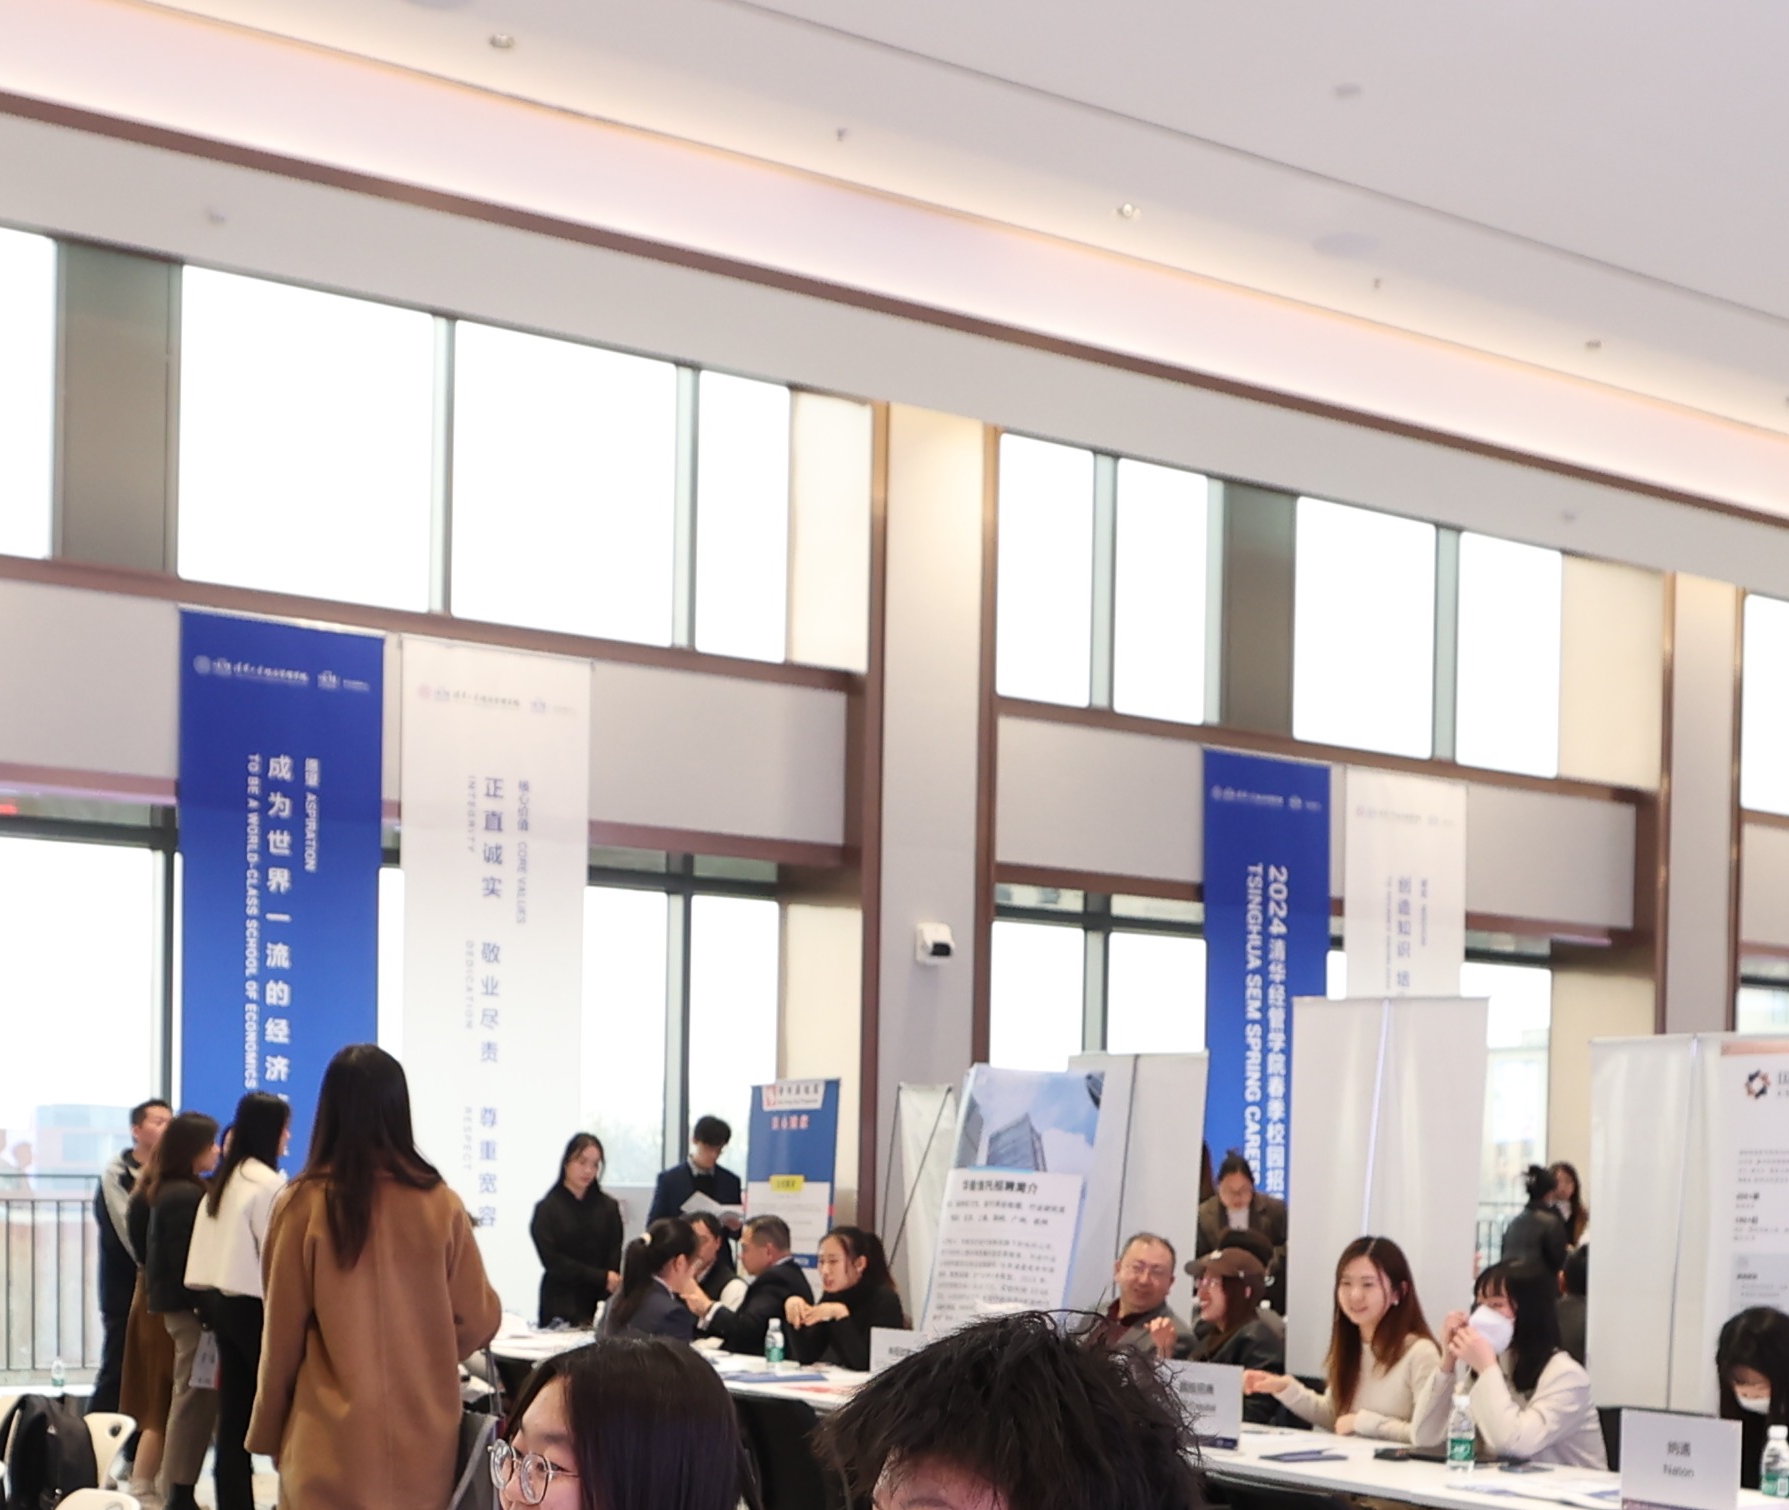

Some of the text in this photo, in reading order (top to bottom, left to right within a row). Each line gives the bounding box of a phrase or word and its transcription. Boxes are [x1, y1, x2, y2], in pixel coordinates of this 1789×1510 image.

[305, 792, 318, 872] ASPIRATION
[482, 777, 503, 898] 正直诚实
[244, 754, 261, 1089] TO BE A WORLD-CLASS SCHOOL OF ECONOMICS
[266, 753, 293, 1100] 成为世界一流的经济
[1246, 863, 1263, 971] TSINGHUA
[480, 942, 501, 1063] 敬业尽责
[1245, 974, 1262, 1021] SEM
[1244, 1023, 1262, 1102] SPRING
[478, 1107, 498, 1227] 尊重宽容
